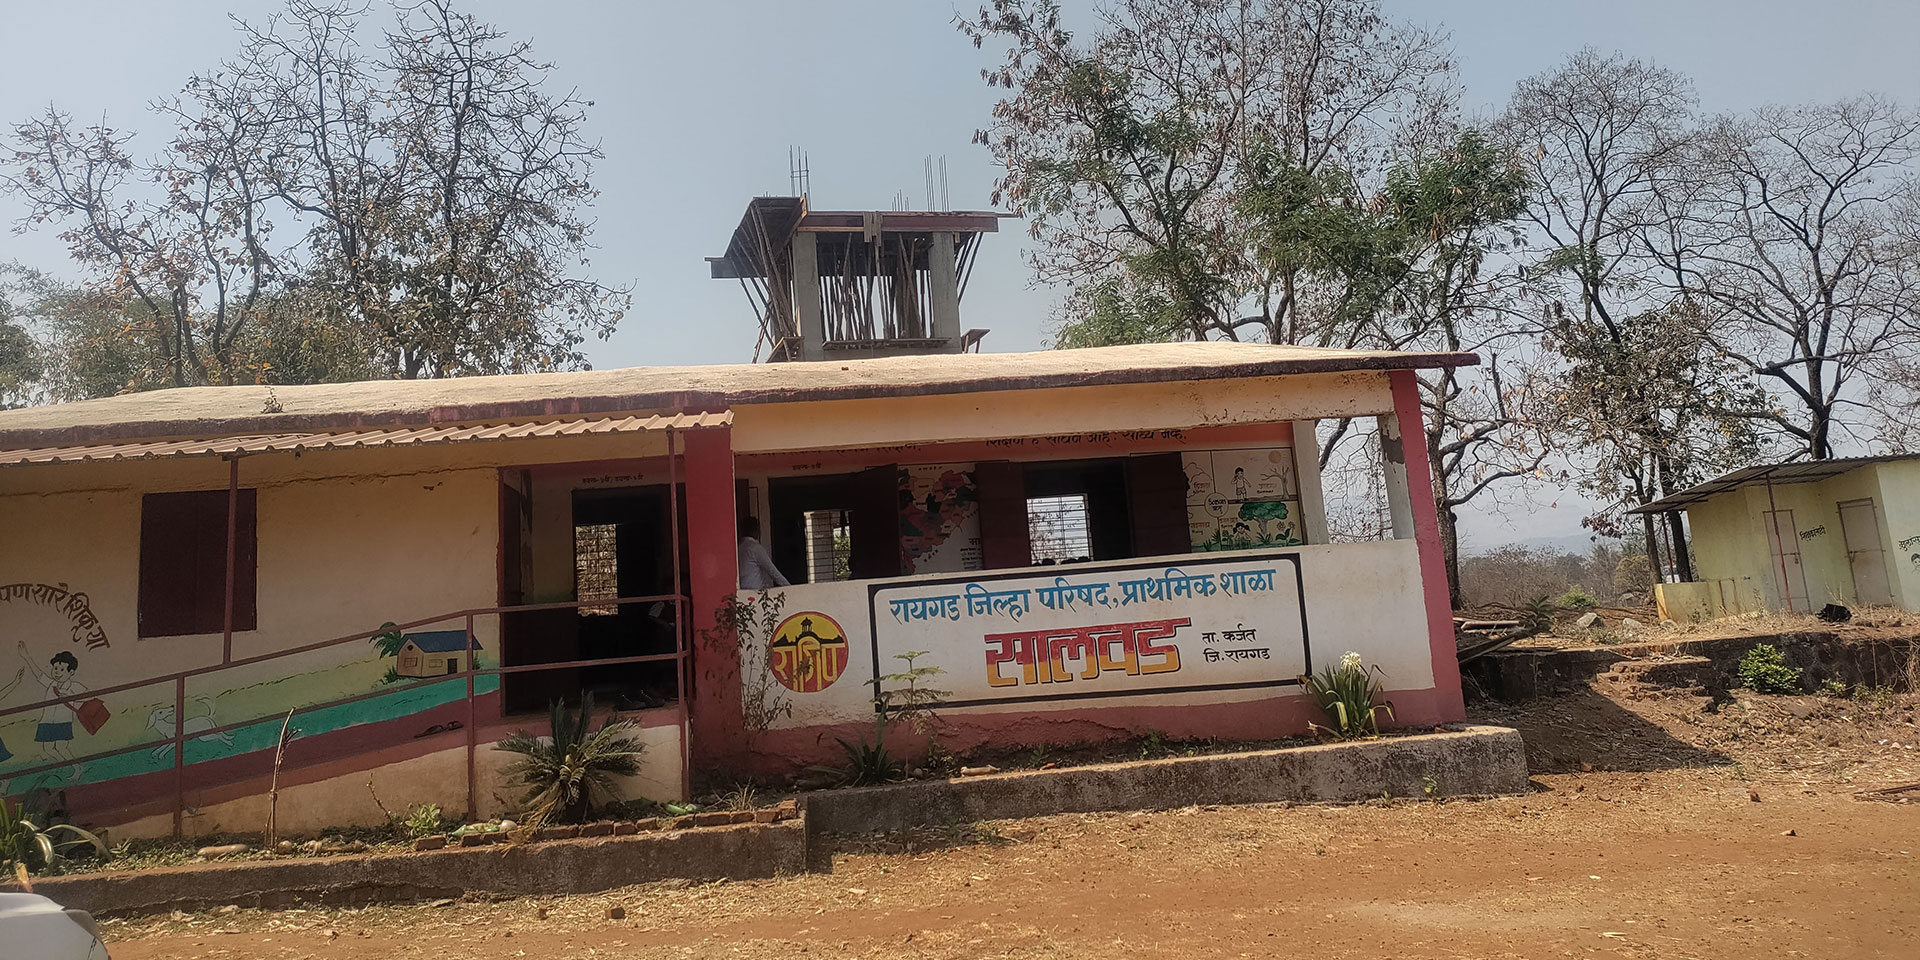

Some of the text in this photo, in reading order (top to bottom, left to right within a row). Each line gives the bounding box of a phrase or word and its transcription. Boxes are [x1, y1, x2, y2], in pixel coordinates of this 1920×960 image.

[32, 582, 70, 612] सारे
[889, 595, 961, 624] रायगड
[964, 583, 1031, 623] जिल्हा
[1117, 568, 1217, 606] प्राथमिक
[1220, 569, 1276, 597] शाळा
[984, 617, 1191, 687] सालवड
[1201, 623, 1256, 644] ता. कर्जत
[772, 636, 846, 692] राजिप
